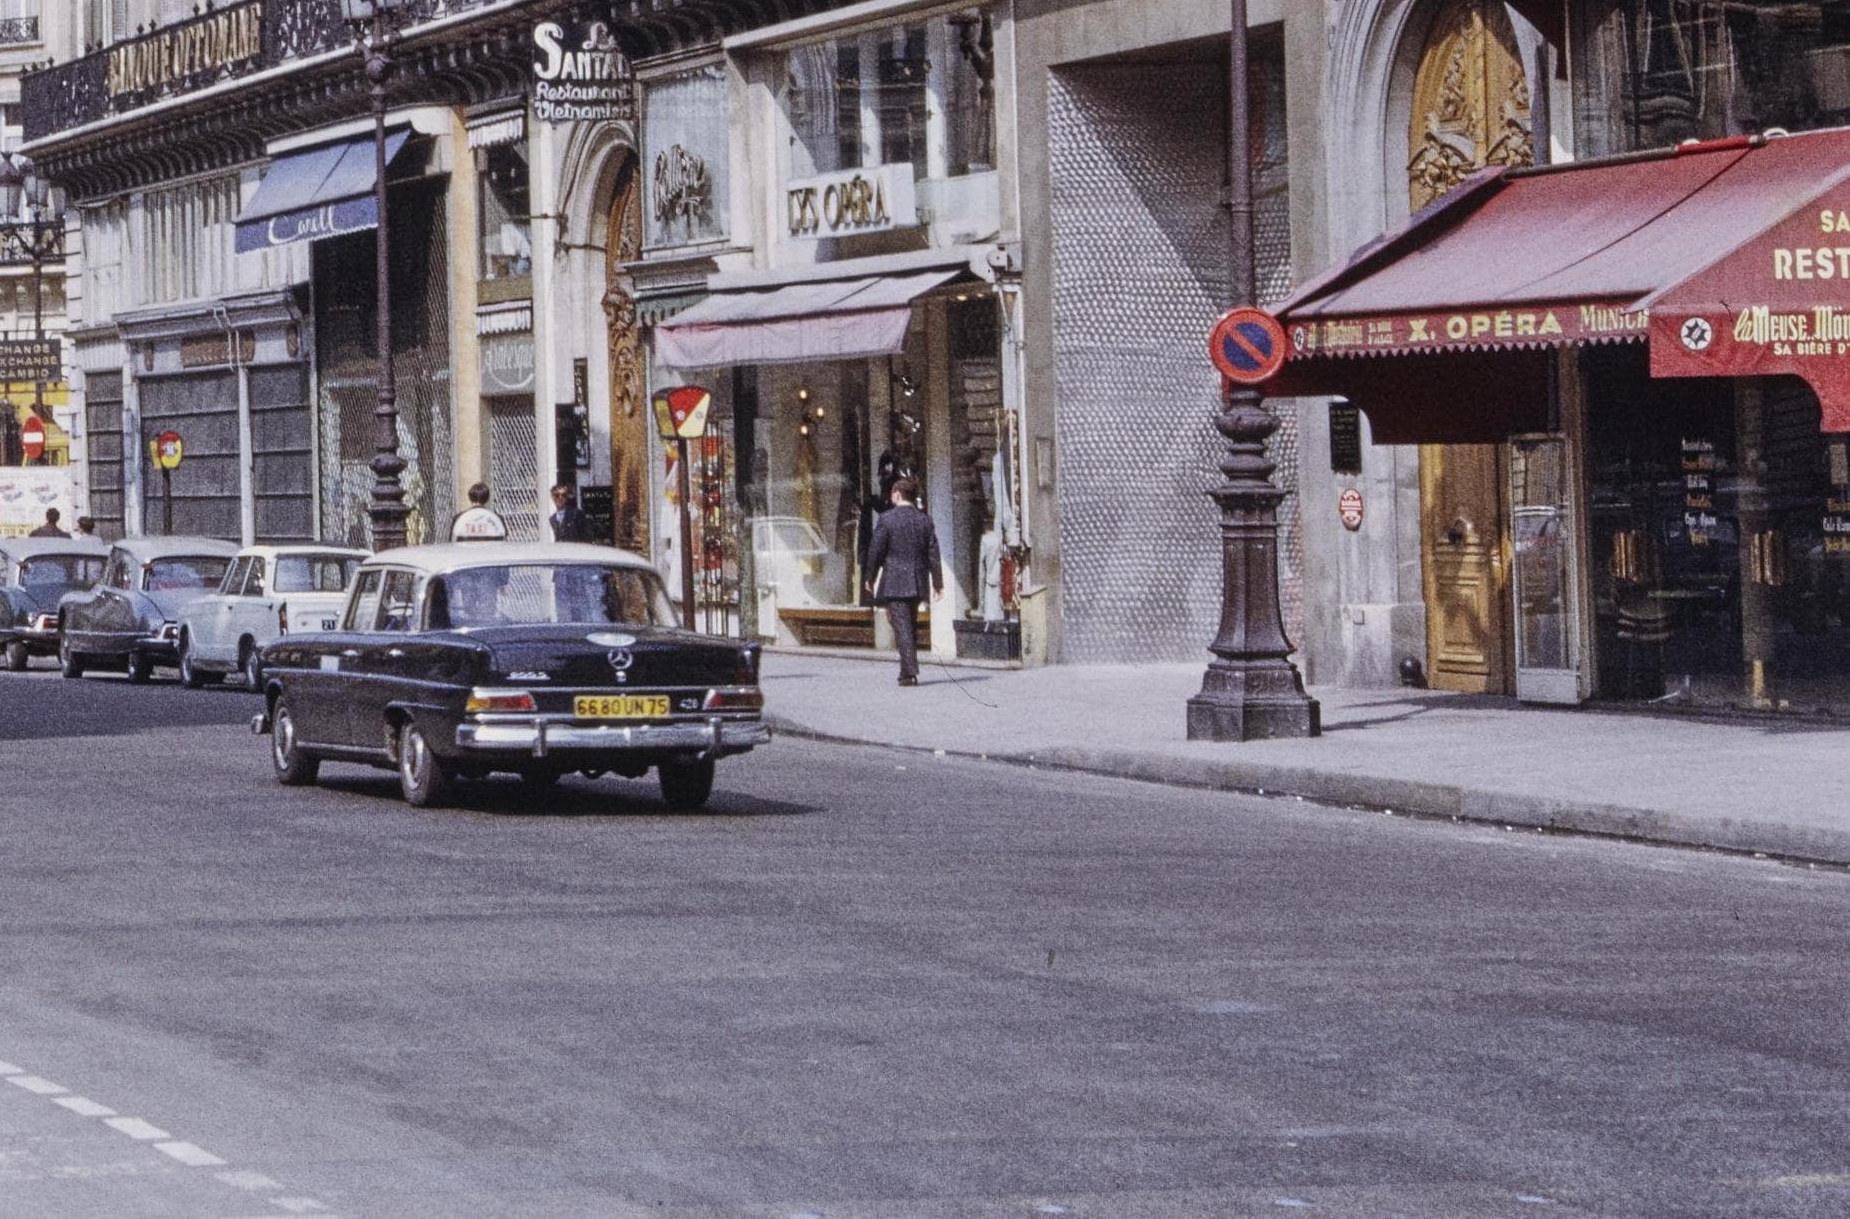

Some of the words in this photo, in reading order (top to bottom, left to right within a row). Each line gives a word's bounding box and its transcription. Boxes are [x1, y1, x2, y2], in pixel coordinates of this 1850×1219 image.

[1446, 310, 1563, 339] OPÉRA
[1774, 342, 1792, 356] SA
[1797, 341, 1832, 356] BIÈRE
[578, 700, 623, 716] 6680
[650, 698, 668, 714] 75
